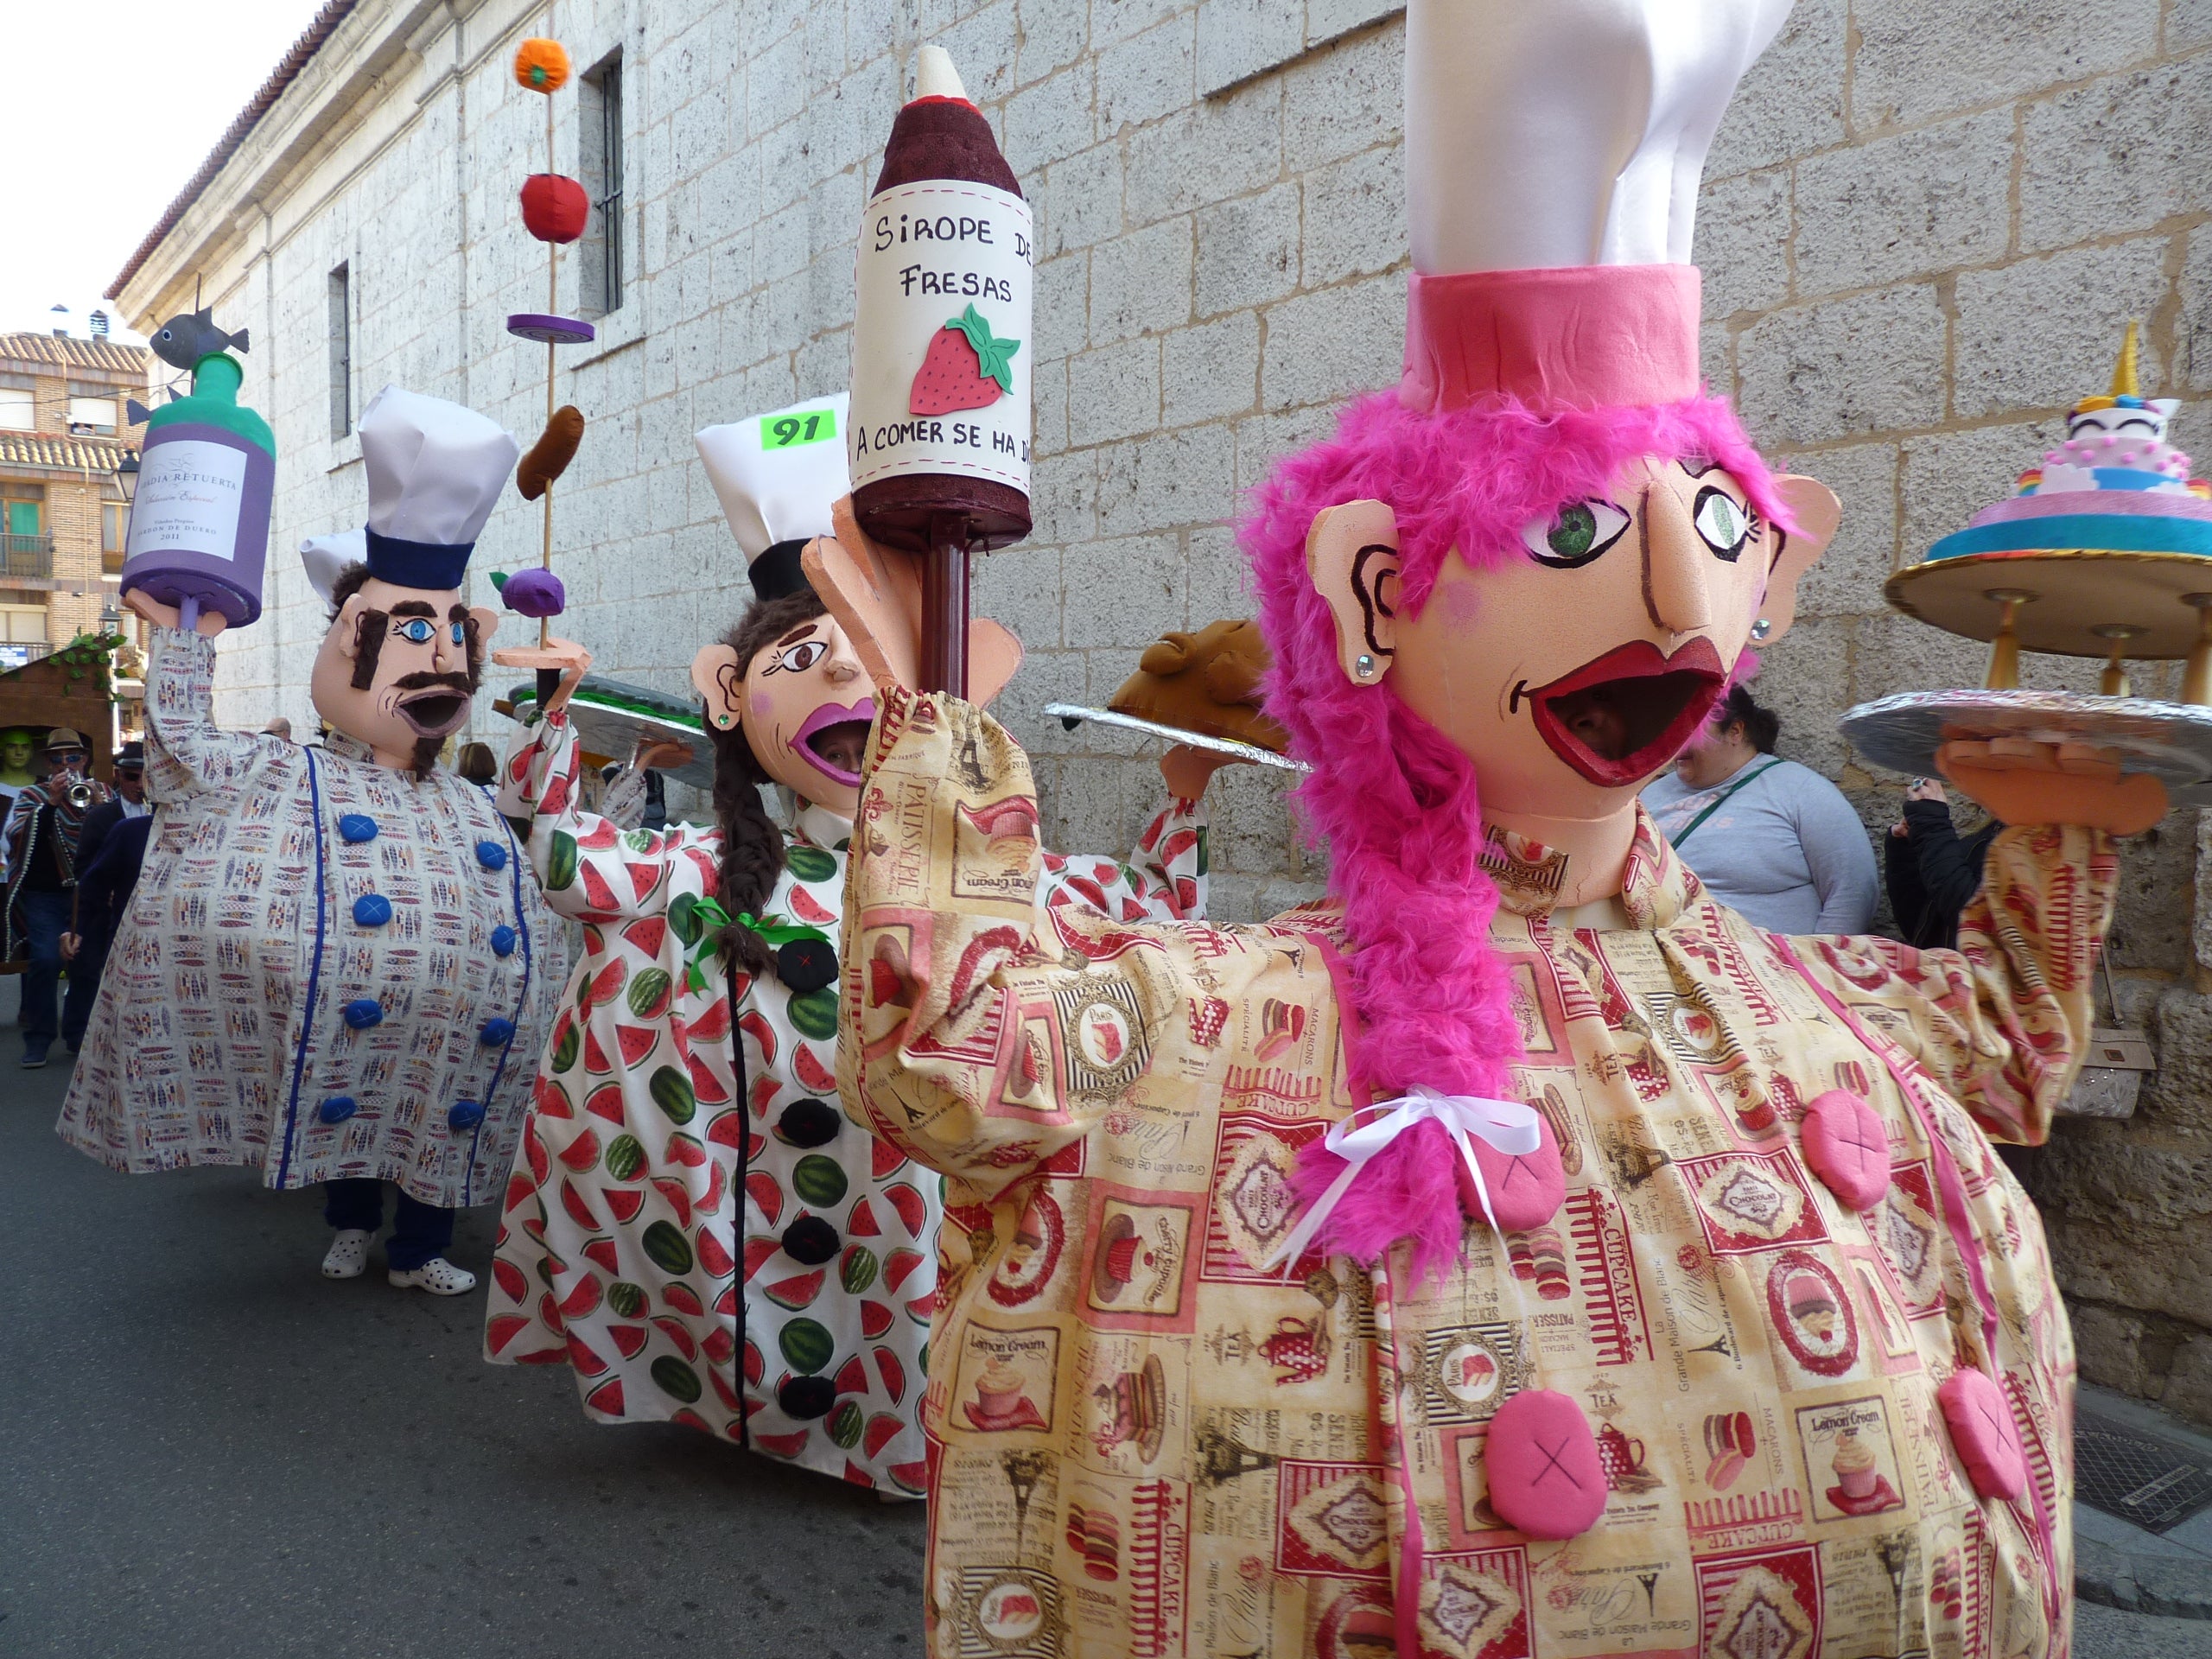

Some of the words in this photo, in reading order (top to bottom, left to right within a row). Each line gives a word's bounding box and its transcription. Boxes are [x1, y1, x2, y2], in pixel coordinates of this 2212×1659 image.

[899, 264, 1012, 302] FRESAS
[772, 415, 821, 446] 91
[856, 426, 868, 461] A
[874, 420, 944, 451] COMER
[953, 423, 982, 448] SE
[993, 430, 1016, 457] HA
[174, 473, 237, 491] RETUERTA
[184, 524, 217, 535] DUERO
[1192, 976, 1217, 987] TEA
[1304, 1007, 1319, 1066] MACARONS
[1603, 1053, 1619, 1081] TEA
[1604, 1228, 1637, 1323] CUPCAKE
[1653, 1258, 1668, 1287] Blanc
[1659, 1290, 1671, 1304] de
[1654, 1321, 1665, 1333] La
[1664, 1306, 1681, 1346] Maison
[1722, 1310, 1730, 1319] de
[1224, 1333, 1241, 1359] TEA
[1724, 1320, 1742, 1362] Boulevard
[1590, 1393, 1618, 1408] TEA
[1812, 1415, 1850, 1431] Lemon
[1851, 1409, 1880, 1425] Cream
[1763, 1408, 1784, 1475] MACARONS
[1707, 1521, 1794, 1549] CUPCAKE
[1161, 1522, 1182, 1618] CUPCAKE
[1980, 1541, 1993, 1633] CUPCAKE
[1559, 1629, 1589, 1641] Blanc
[1592, 1626, 1607, 1637] de
[1609, 1624, 1648, 1636] Maison
[1650, 1619, 1692, 1633] Grande
